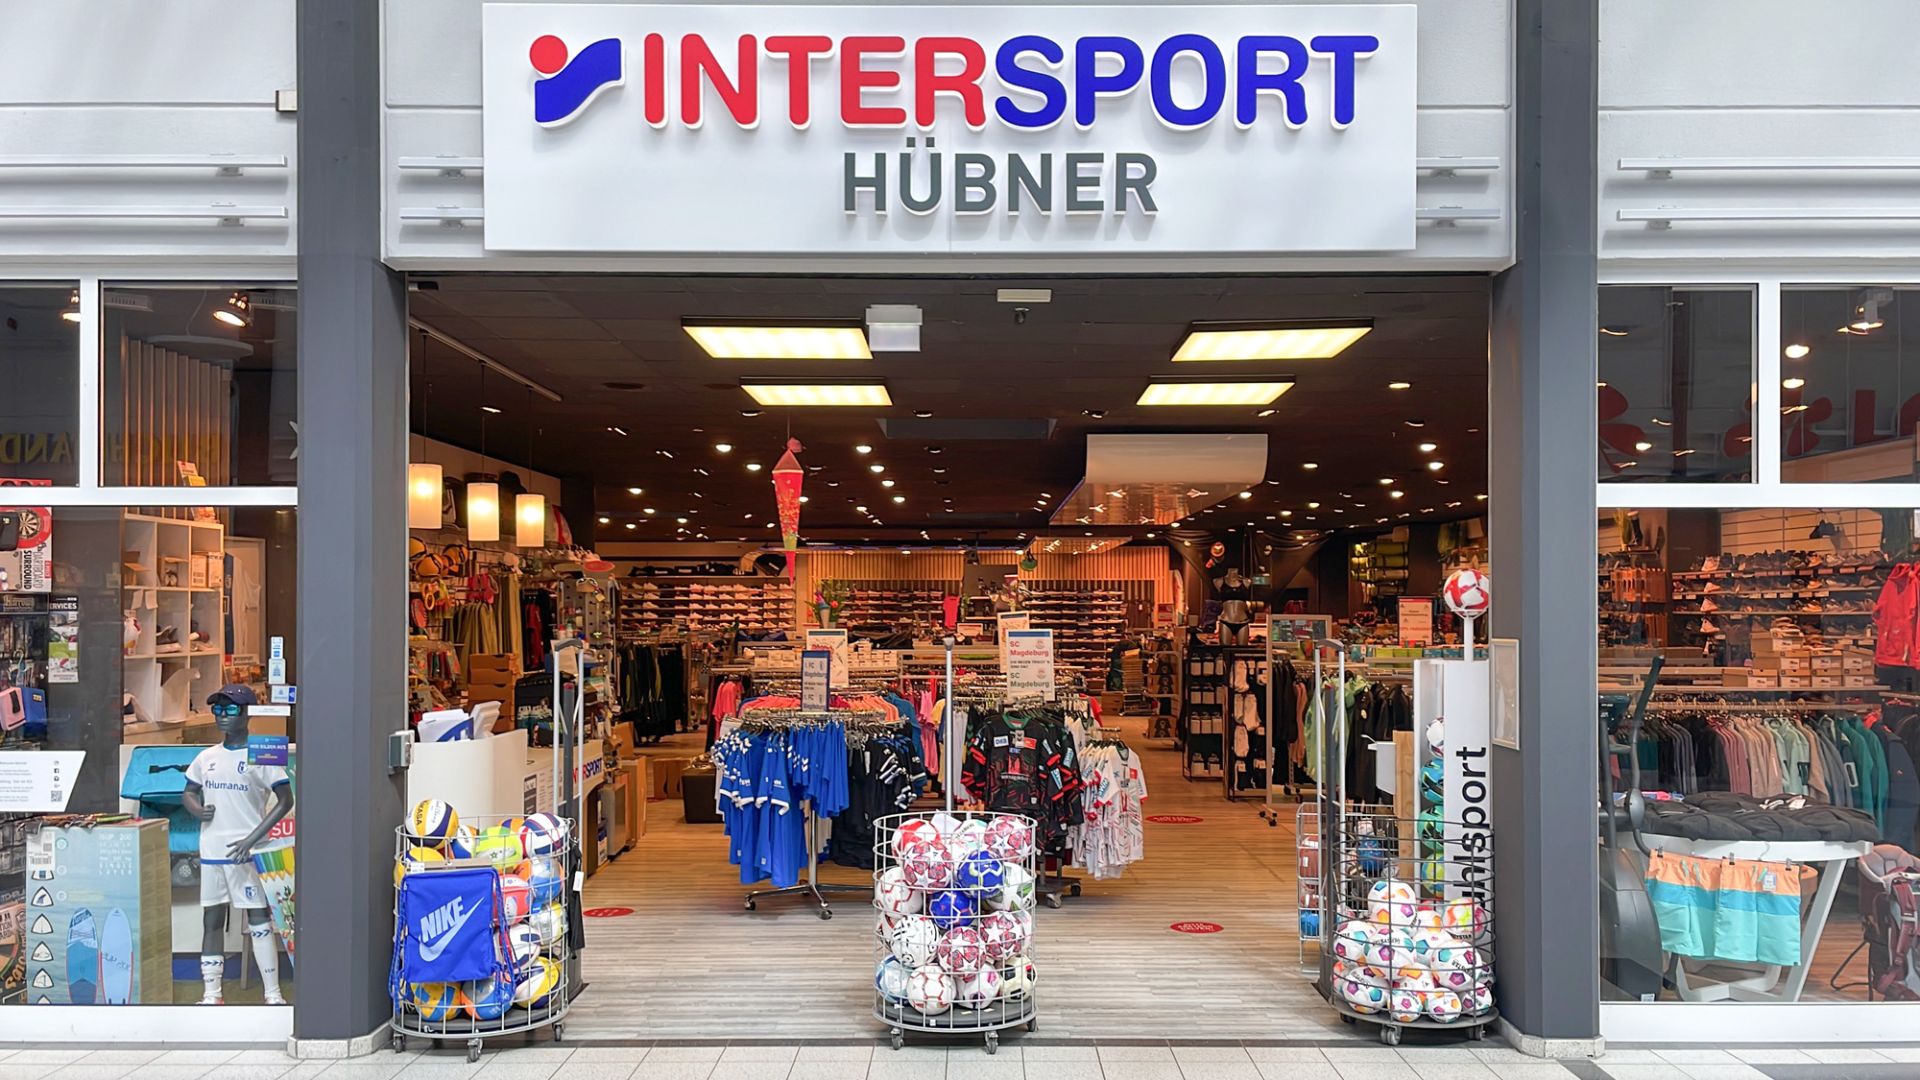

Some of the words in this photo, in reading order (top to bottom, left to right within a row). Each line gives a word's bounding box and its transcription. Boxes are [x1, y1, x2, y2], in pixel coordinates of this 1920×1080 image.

[644, 33, 1381, 130] INTERSPORT
[843, 137, 1160, 215] HÜBNER
[24, 550, 32, 589] SURROUND
[1010, 649, 1049, 657] Magdeburg
[208, 780, 249, 792] Humanas
[420, 895, 464, 943] NIKE
